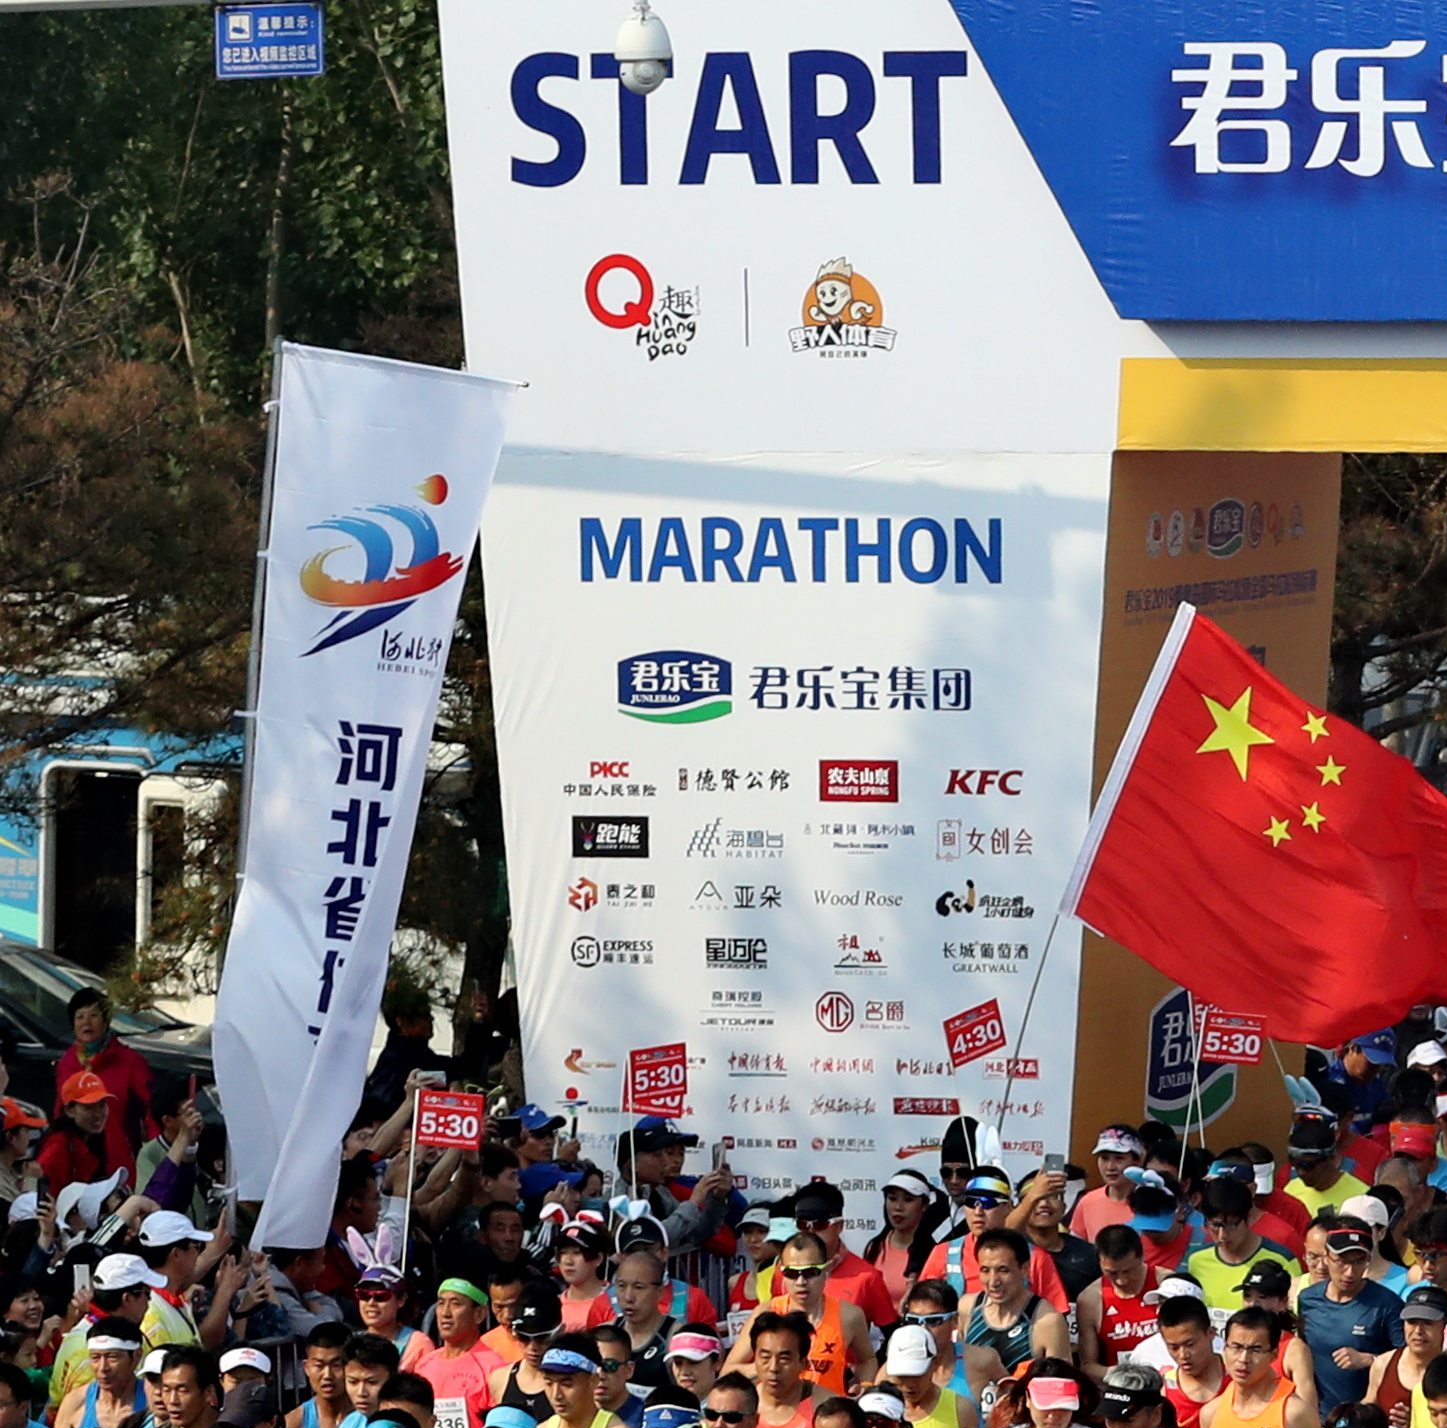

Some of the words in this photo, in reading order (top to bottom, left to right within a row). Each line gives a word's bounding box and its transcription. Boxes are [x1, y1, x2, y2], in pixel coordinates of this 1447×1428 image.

[510, 50, 968, 187] START
[788, 322, 898, 352] 野人体育
[579, 517, 1002, 584] MARATHON
[629, 660, 721, 693] 君乐宝
[630, 693, 681, 704] JUNLEBAO
[748, 665, 973, 712] 君乐宝集团
[590, 761, 630, 778] PICC
[828, 767, 890, 785] 农夫山泉
[563, 783, 657, 797] 中国人民保险
[860, 786, 889, 796] SPRING
[943, 769, 1024, 795] KFC
[966, 828, 1034, 855] 女创会
[726, 850, 784, 859] HABITAT
[734, 885, 783, 908] 亚朵
[813, 889, 860, 906] Wood
[864, 889, 904, 907] Rose
[577, 945, 594, 960] SF
[603, 940, 653, 951] EXPRESS
[942, 942, 1029, 959] 长城葡萄酒
[952, 963, 1019, 974] GREATWALL
[820, 996, 850, 1027] MG
[865, 1001, 904, 1021] 名爵
[953, 1018, 1001, 1054] 4:30
[1205, 1031, 1260, 1056] 5:30
[634, 1064, 685, 1091] 5:30
[419, 1109, 480, 1138] 5:30
